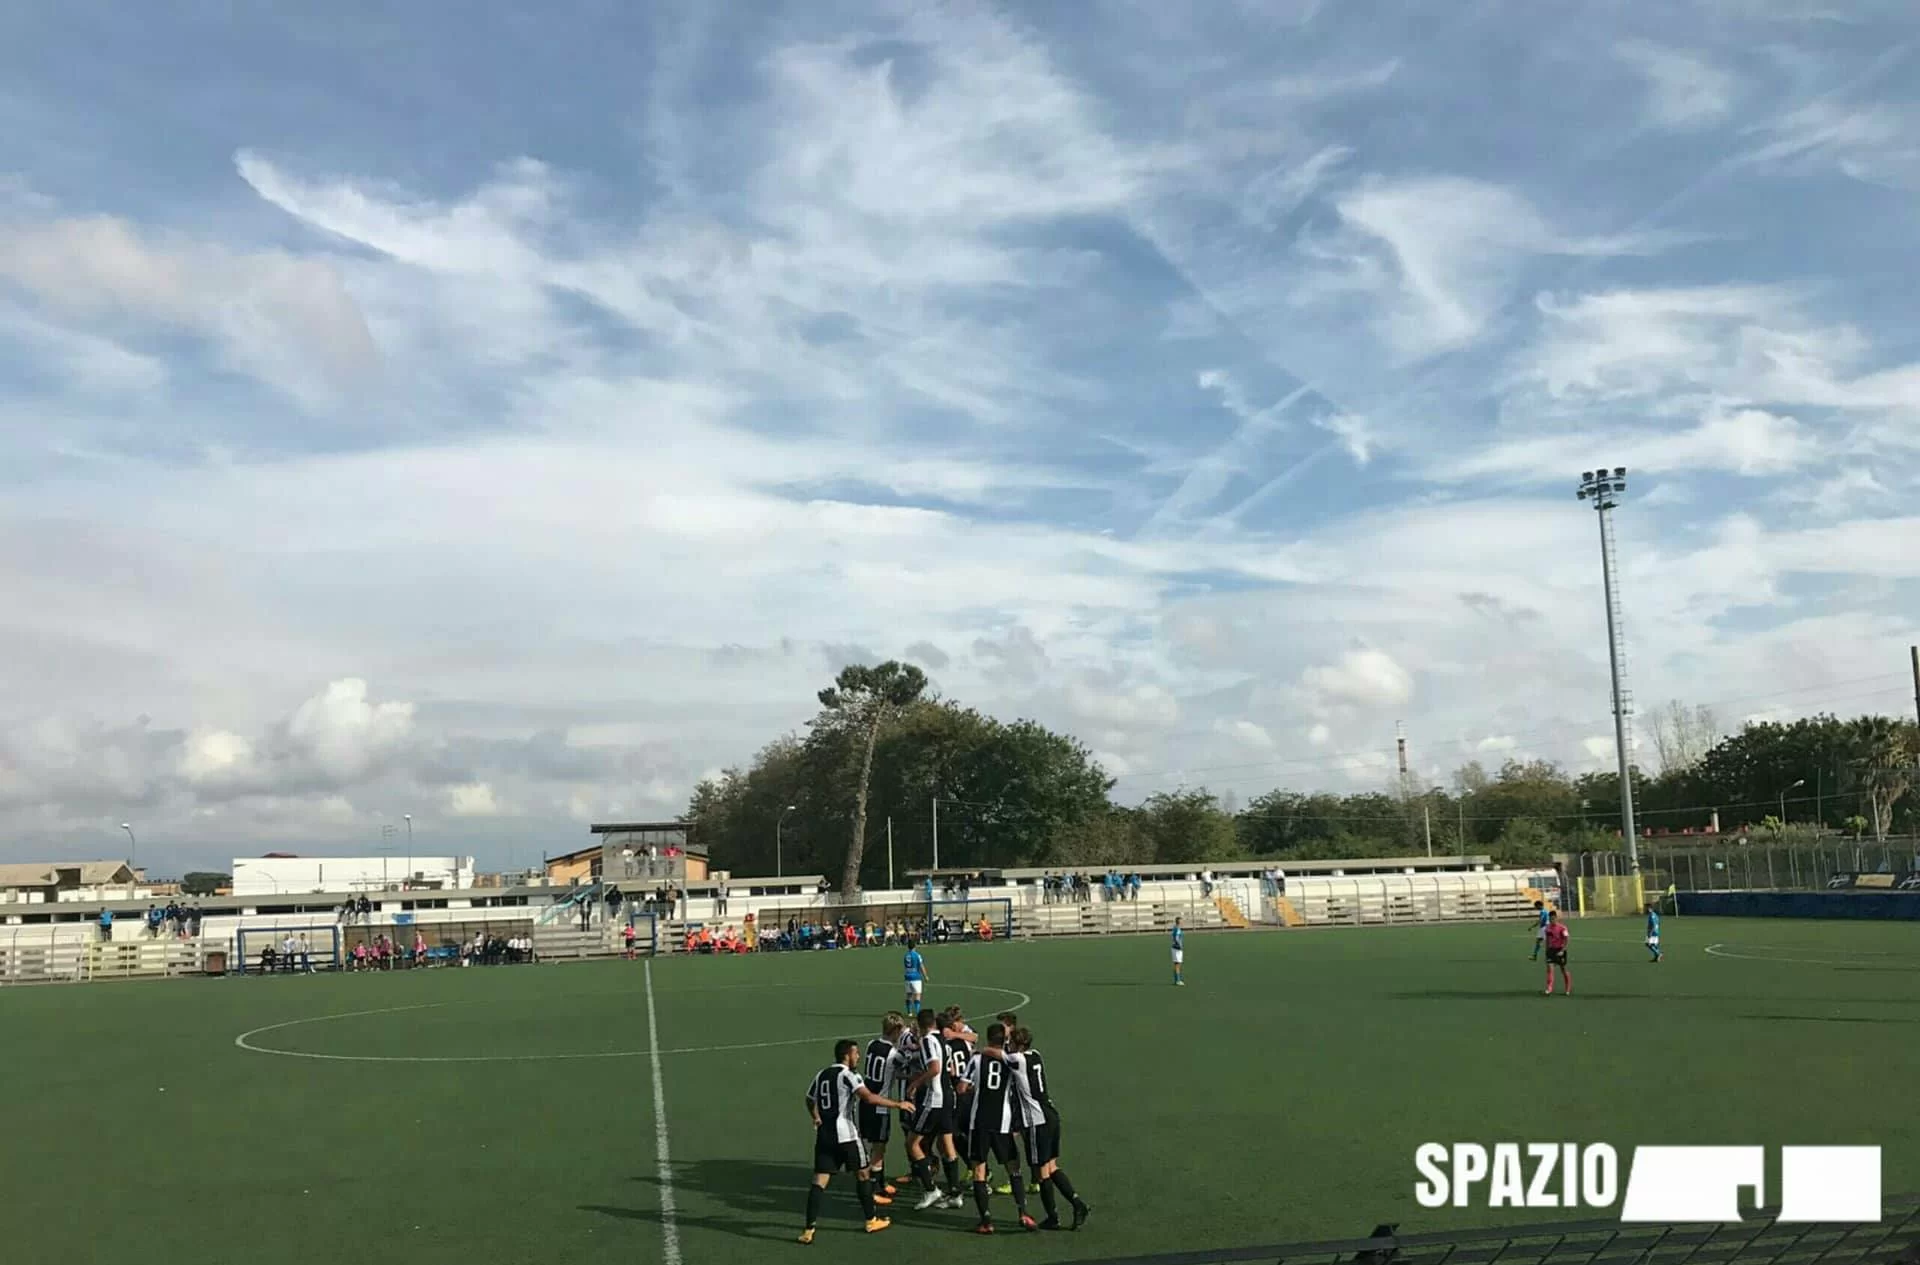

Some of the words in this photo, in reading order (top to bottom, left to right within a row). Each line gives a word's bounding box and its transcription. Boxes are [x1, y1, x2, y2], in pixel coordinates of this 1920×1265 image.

[865, 1052, 885, 1083] 10
[987, 1060, 1002, 1090] 8
[1032, 1063, 1044, 1093] 7
[820, 1079, 832, 1110] 9
